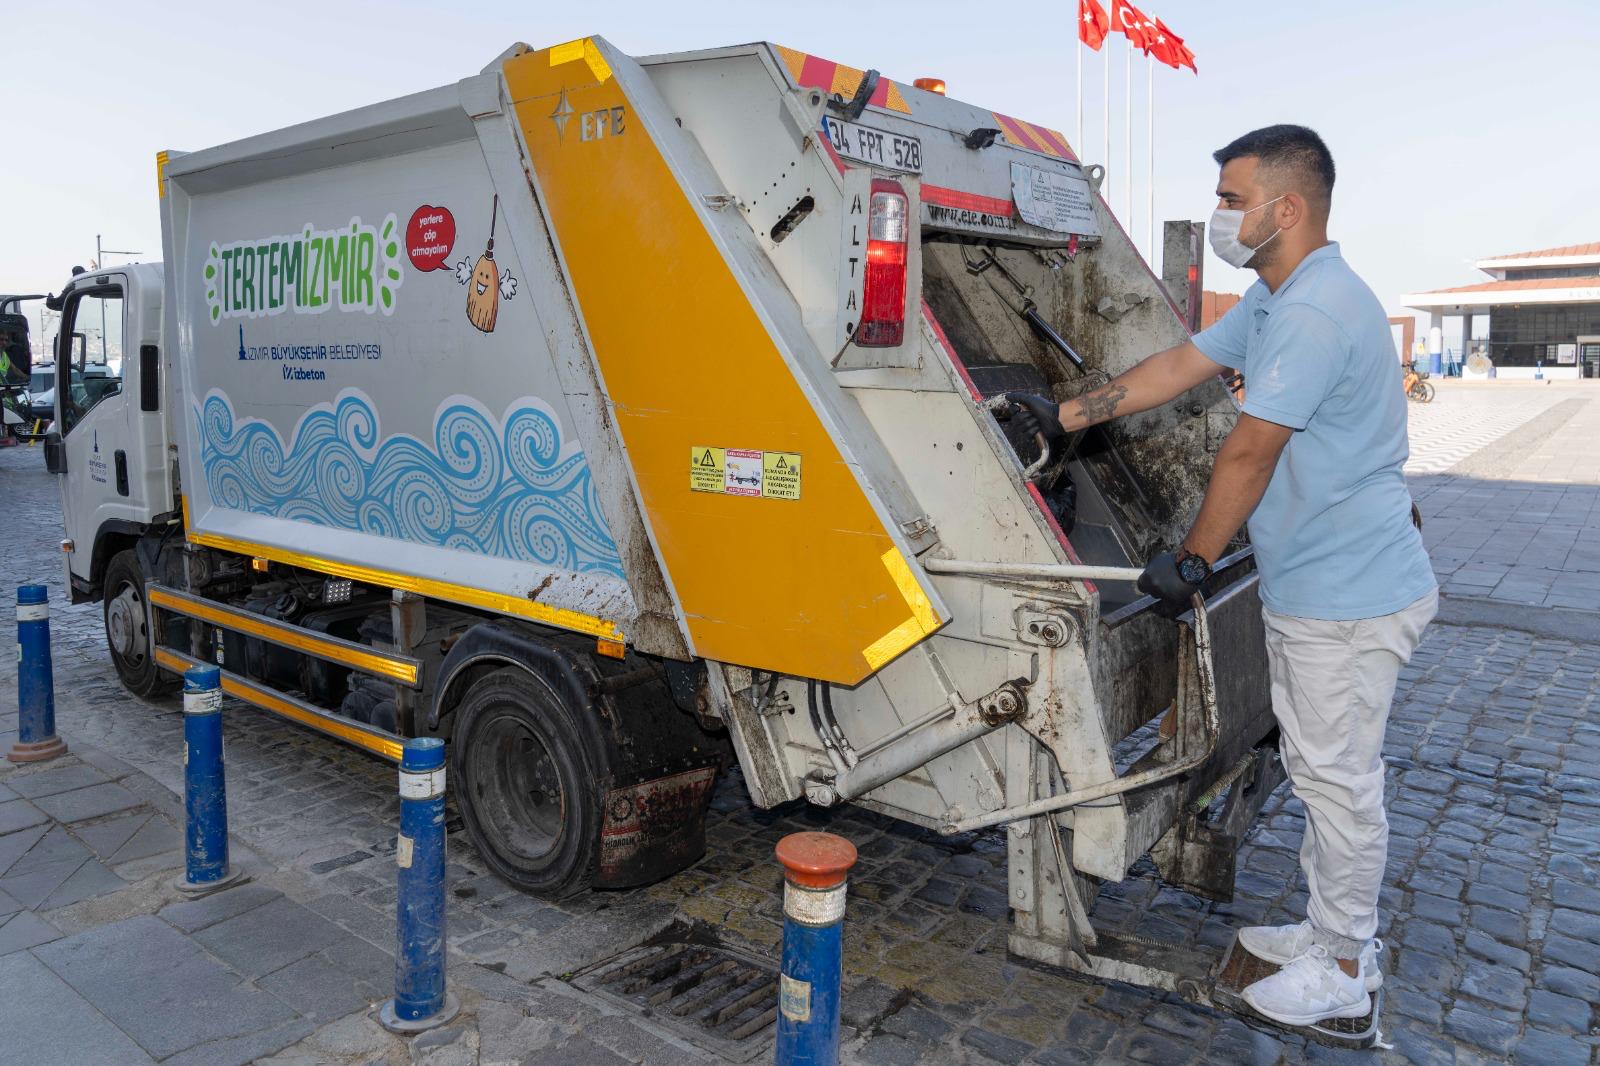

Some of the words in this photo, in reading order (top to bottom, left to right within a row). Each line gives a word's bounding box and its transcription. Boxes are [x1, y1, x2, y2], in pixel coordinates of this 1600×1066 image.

[579, 105, 625, 143] EFE
[829, 121, 850, 154] 34
[857, 128, 883, 163] FPT
[893, 138, 921, 170] 528
[271, 343, 327, 362] BÜYÜKŞEHİR
